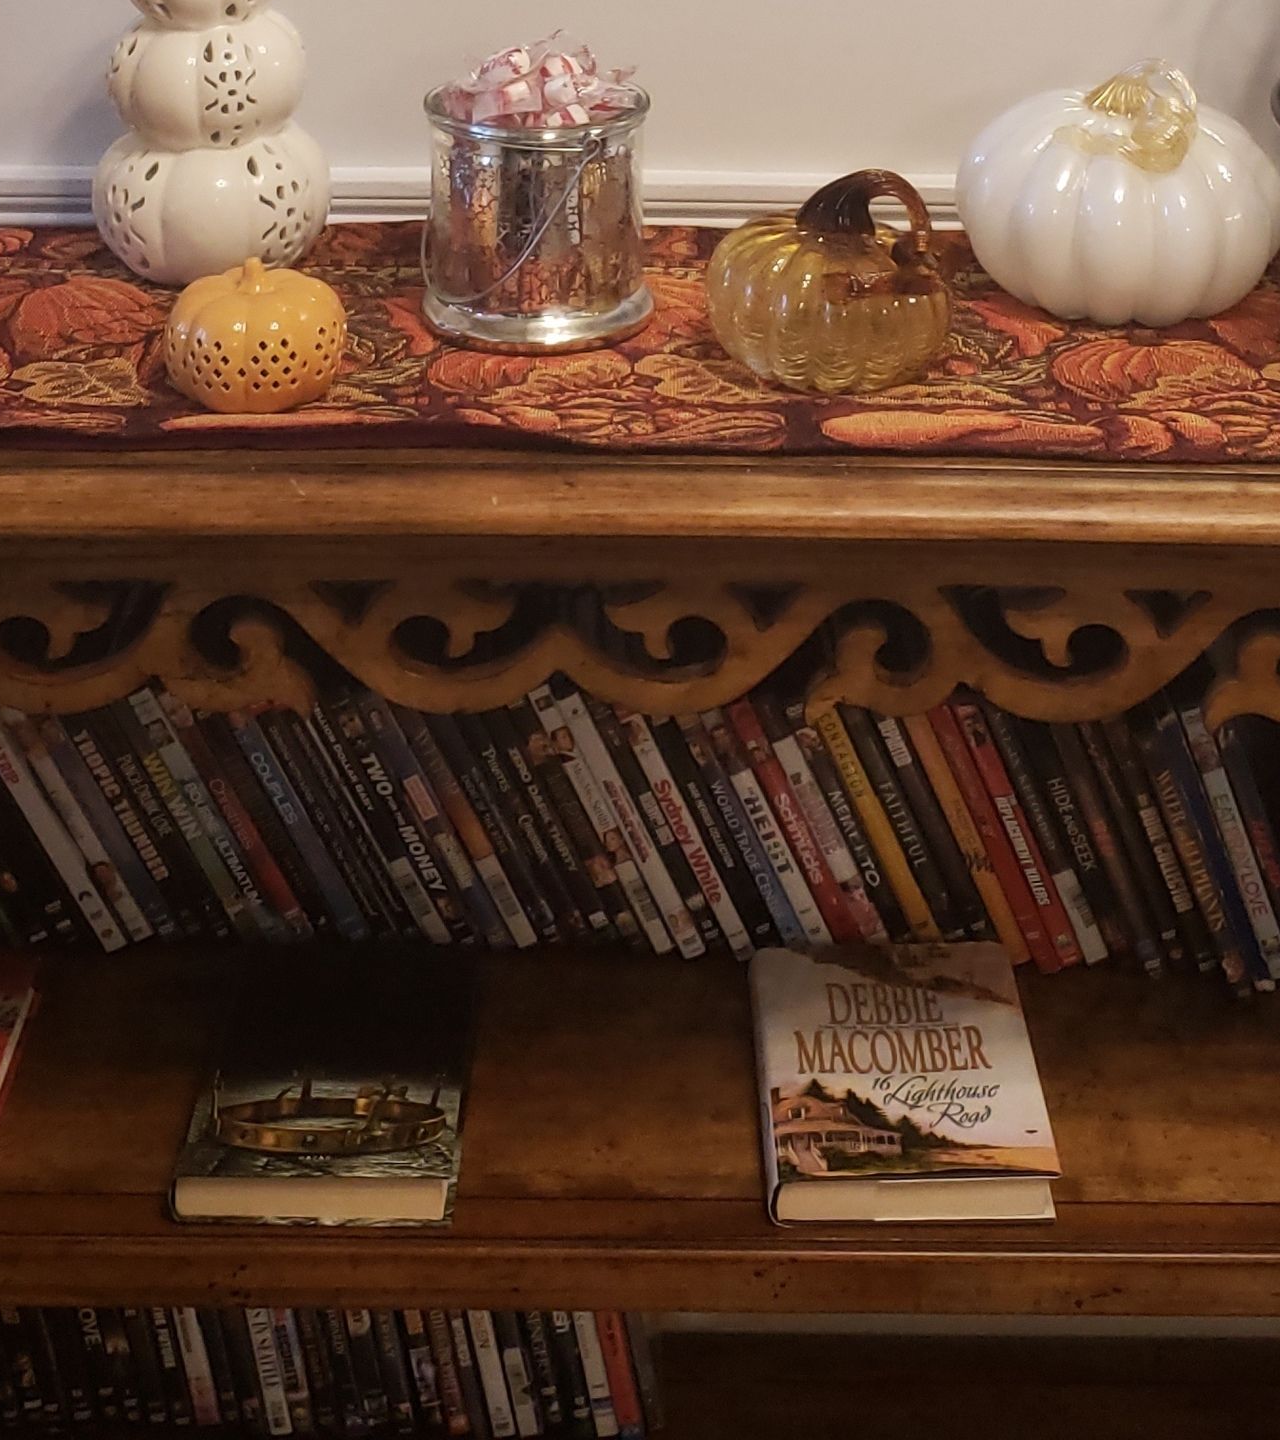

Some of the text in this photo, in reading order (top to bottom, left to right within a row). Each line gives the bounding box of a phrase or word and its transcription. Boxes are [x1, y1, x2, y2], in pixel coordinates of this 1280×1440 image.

[140, 748, 203, 843] WIN WIN
[248, 748, 299, 827] COUPLES
[331, 742, 359, 784] DOLLAR
[353, 782, 375, 813] BABY
[815, 711, 869, 800] CONTAGION
[1152, 768, 1189, 824] WATER
[70, 726, 171, 886] TROPIC THUNDER
[182, 779, 264, 910] BOURNE ULTIMATUM
[359, 751, 395, 800] TWO
[397, 820, 448, 897] MONEY
[505, 744, 579, 874] ZERO DARK THIRTY
[651, 777, 727, 906] Sydney White
[707, 778, 763, 873] WORLD TRADE
[741, 792, 795, 879] HEIST
[770, 790, 828, 886] Schmucks
[990, 793, 1052, 908] REPLACEMENT KILLERS
[1045, 775, 1098, 874] HIDE AND SEEK
[1212, 792, 1236, 827] EAT
[1239, 869, 1268, 918] LOVE
[793, 1024, 993, 1076] MACOMBER
[825, 983, 944, 1026] DEBBIE
[871, 1075, 1001, 1111] 16 Lighthouse
[926, 1102, 992, 1129] Road
